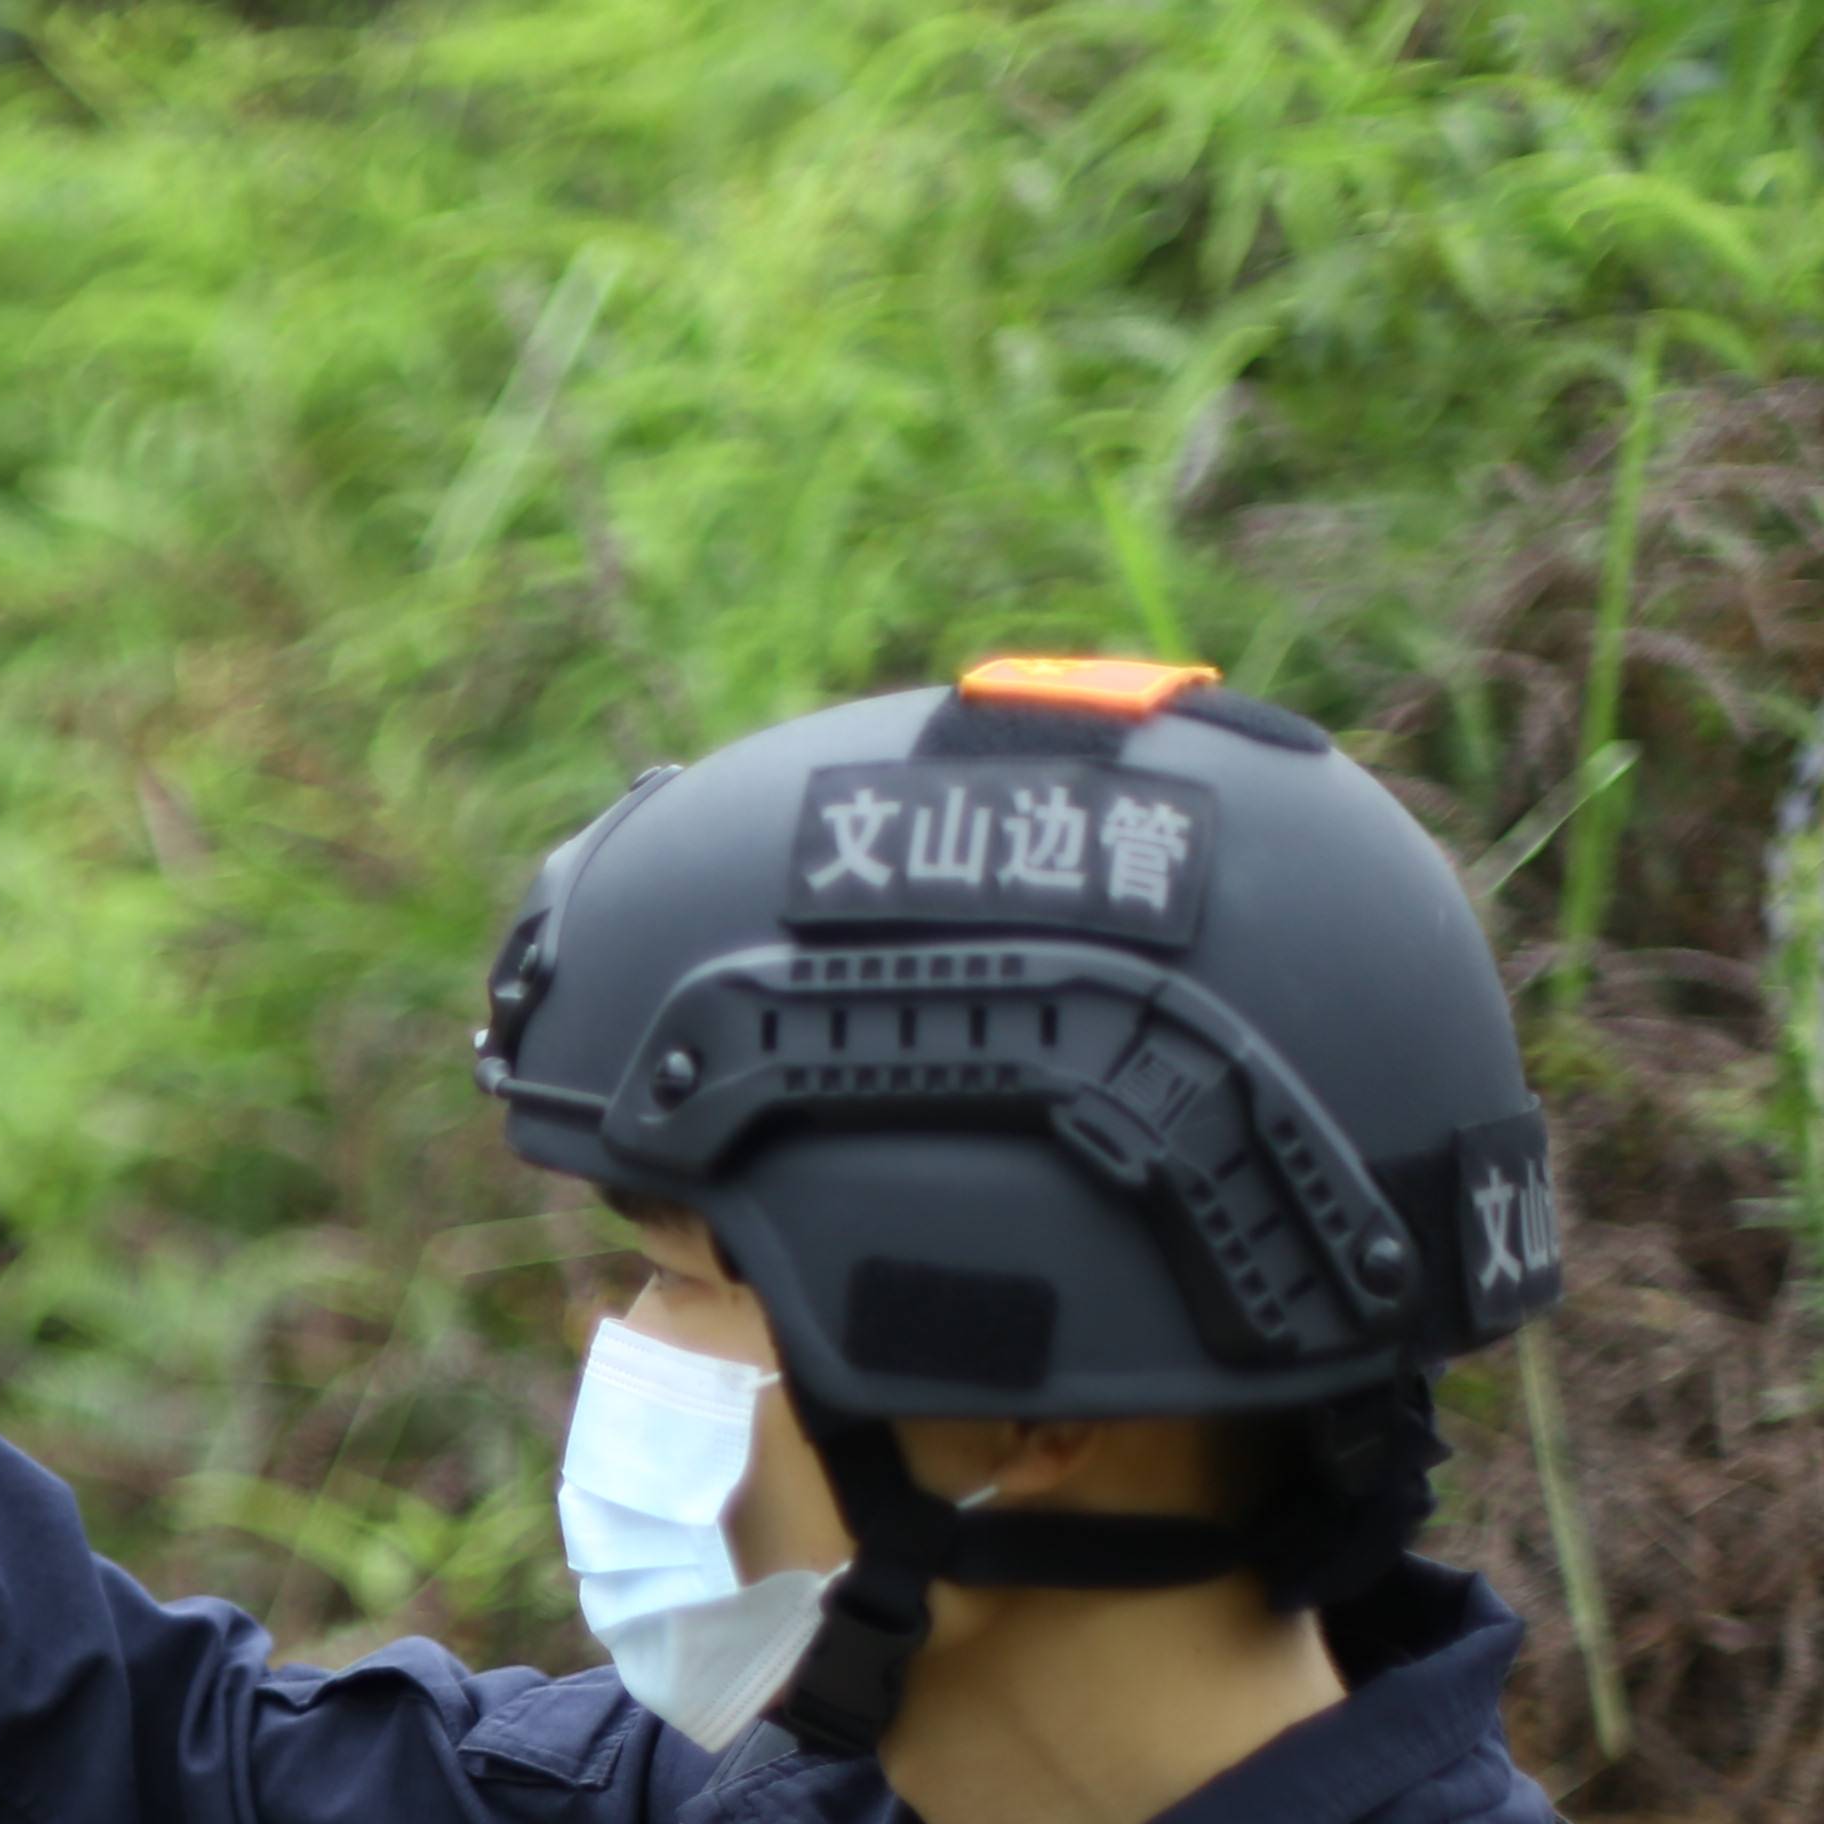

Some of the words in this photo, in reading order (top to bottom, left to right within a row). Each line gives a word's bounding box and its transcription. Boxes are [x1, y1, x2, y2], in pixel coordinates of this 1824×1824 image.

[805, 785, 1194, 912] 文山边管
[1473, 1160, 1560, 1289] 文山
